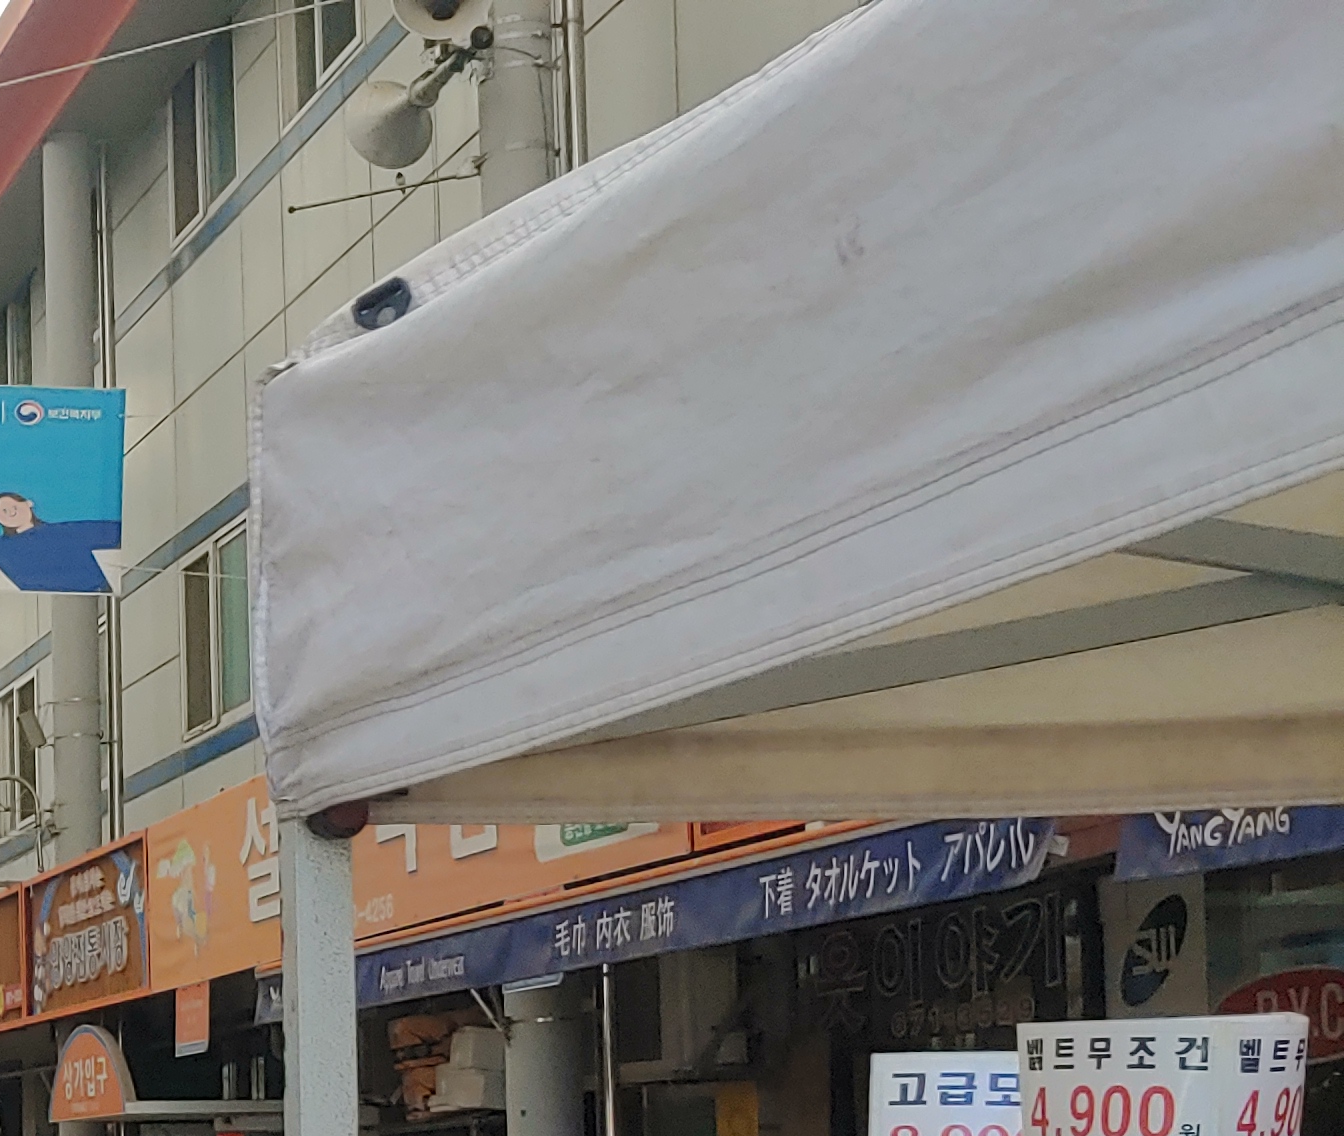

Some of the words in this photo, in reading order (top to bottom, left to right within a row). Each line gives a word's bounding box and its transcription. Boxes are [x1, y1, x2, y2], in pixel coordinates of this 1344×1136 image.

[805, 841, 921, 911] タオルケット
[941, 816, 1036, 882] アパレル
[63, 1055, 109, 1100] 상가입구
